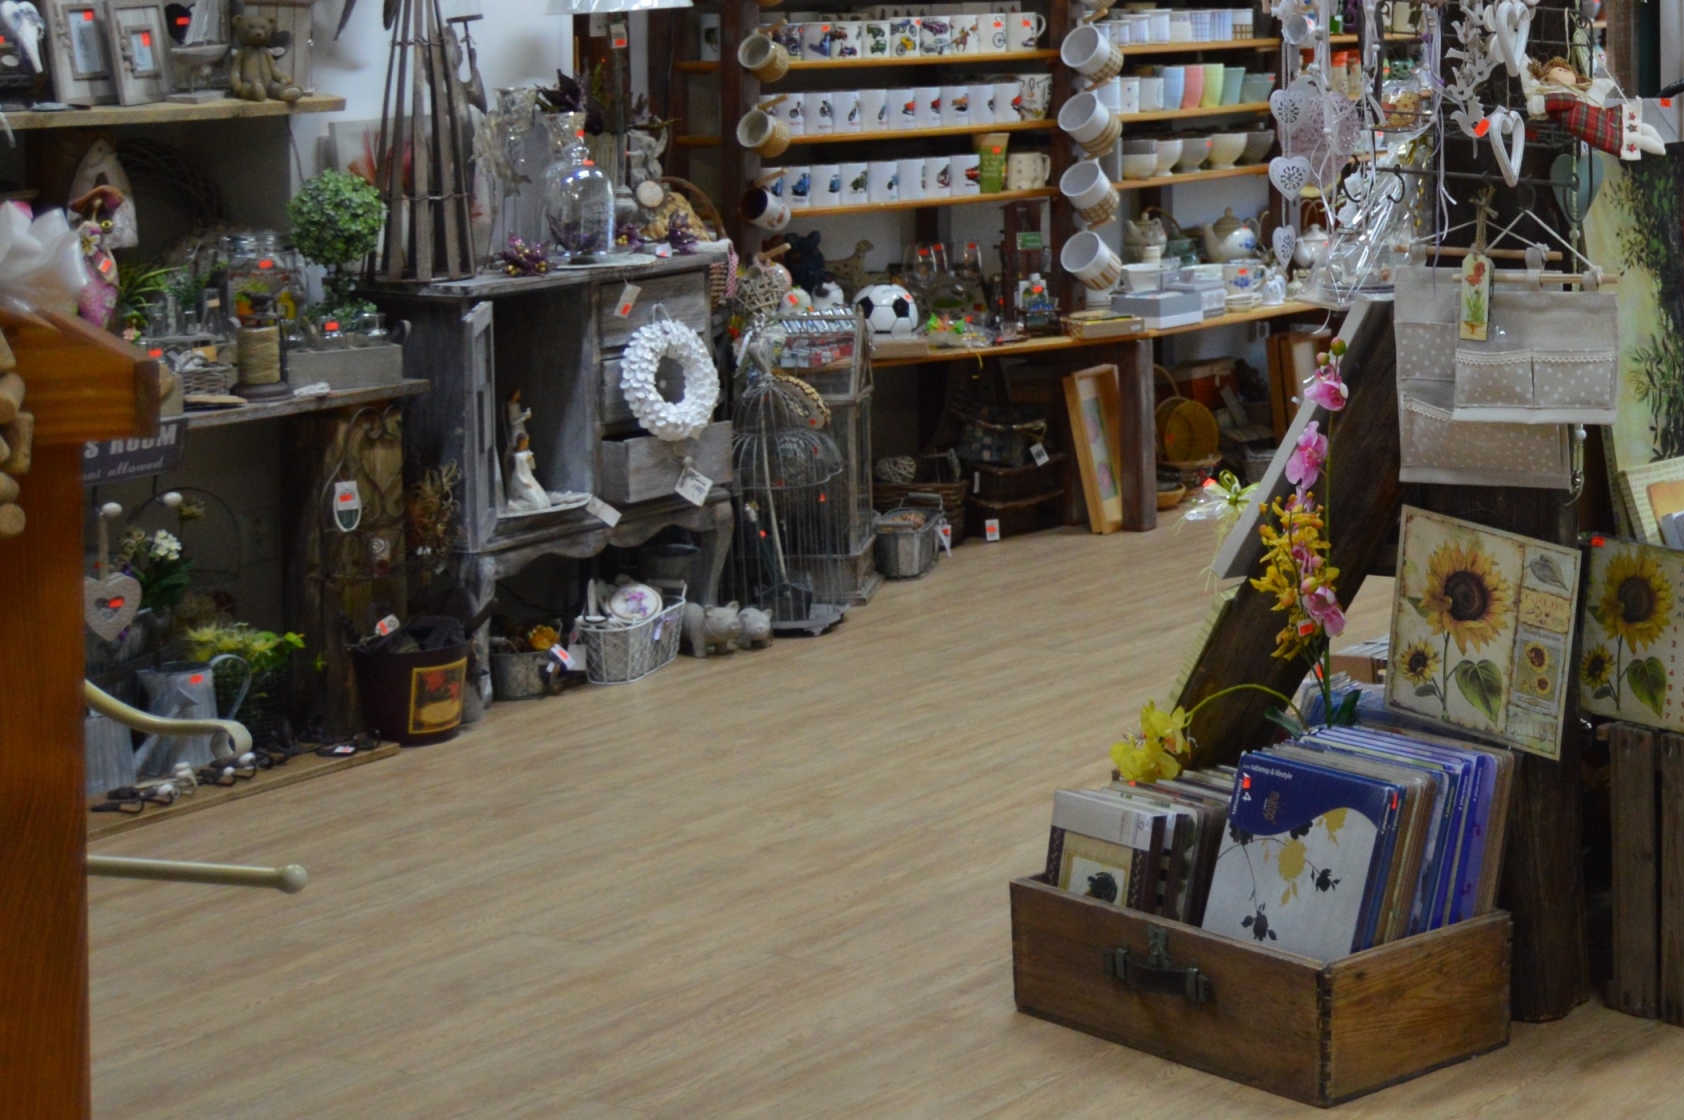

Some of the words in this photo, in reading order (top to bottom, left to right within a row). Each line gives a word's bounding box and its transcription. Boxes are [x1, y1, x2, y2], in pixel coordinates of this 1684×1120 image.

[108, 456, 164, 477] allowed
[1242, 791, 1252, 802] 4
[1264, 791, 1280, 820] matop
